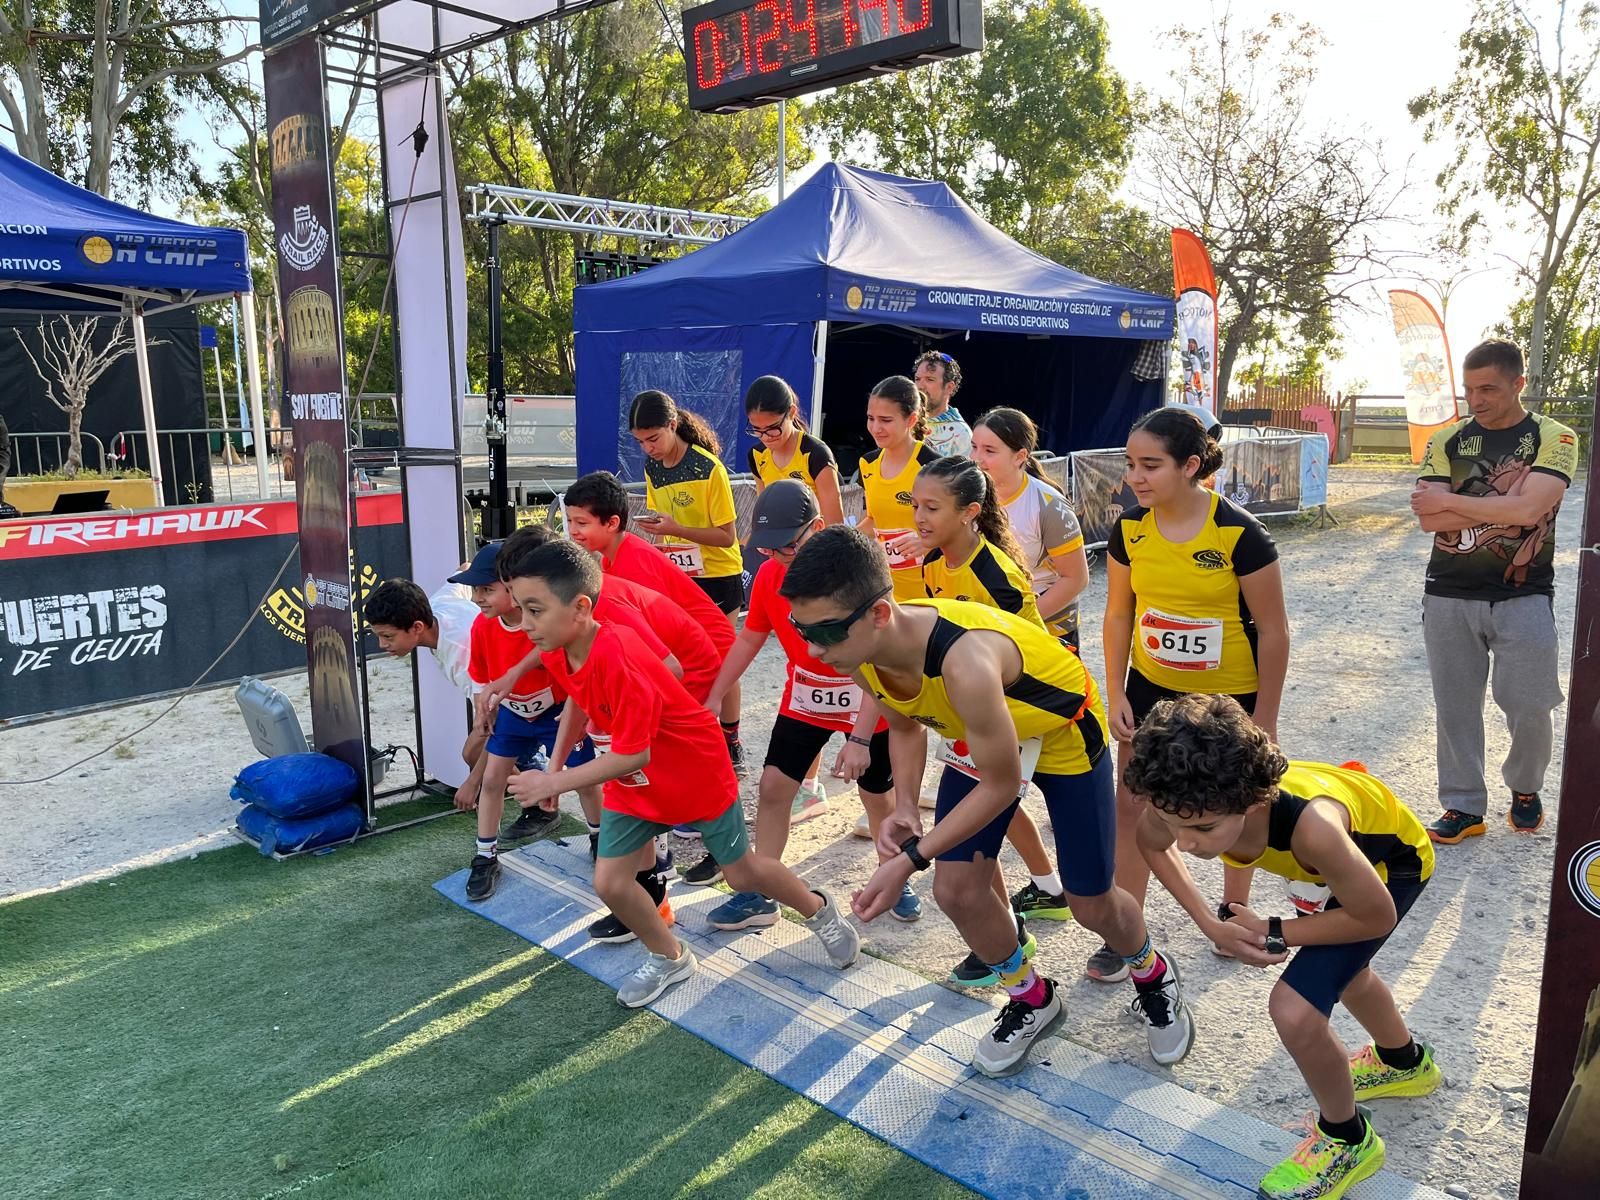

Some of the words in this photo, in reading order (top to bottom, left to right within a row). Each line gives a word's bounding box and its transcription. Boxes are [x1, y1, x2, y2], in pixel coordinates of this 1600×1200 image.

[0, 258, 61, 271] RTIVOS
[928, 290, 1001, 308] CRONOMETRAJE
[1003, 297, 1063, 313] ORGANIZACIÓN
[1063, 303, 1070, 313] Y
[1070, 302, 1101, 316] GESTIÓN
[1101, 305, 1112, 317] DE
[981, 312, 1019, 326] EVENTOS
[1020, 315, 1070, 330] DEPORTIVOS
[291, 393, 309, 420] SOY
[0, 507, 268, 548] FIREHAWK
[669, 553, 695, 567] 611
[0, 584, 168, 647] UERTES
[260, 604, 278, 626] LOS
[277, 621, 307, 646] FUER
[12, 646, 59, 676] DE
[70, 629, 163, 666] CEUTA
[1161, 631, 1207, 655] 615
[509, 700, 544, 713] 612
[811, 689, 851, 707] 616
